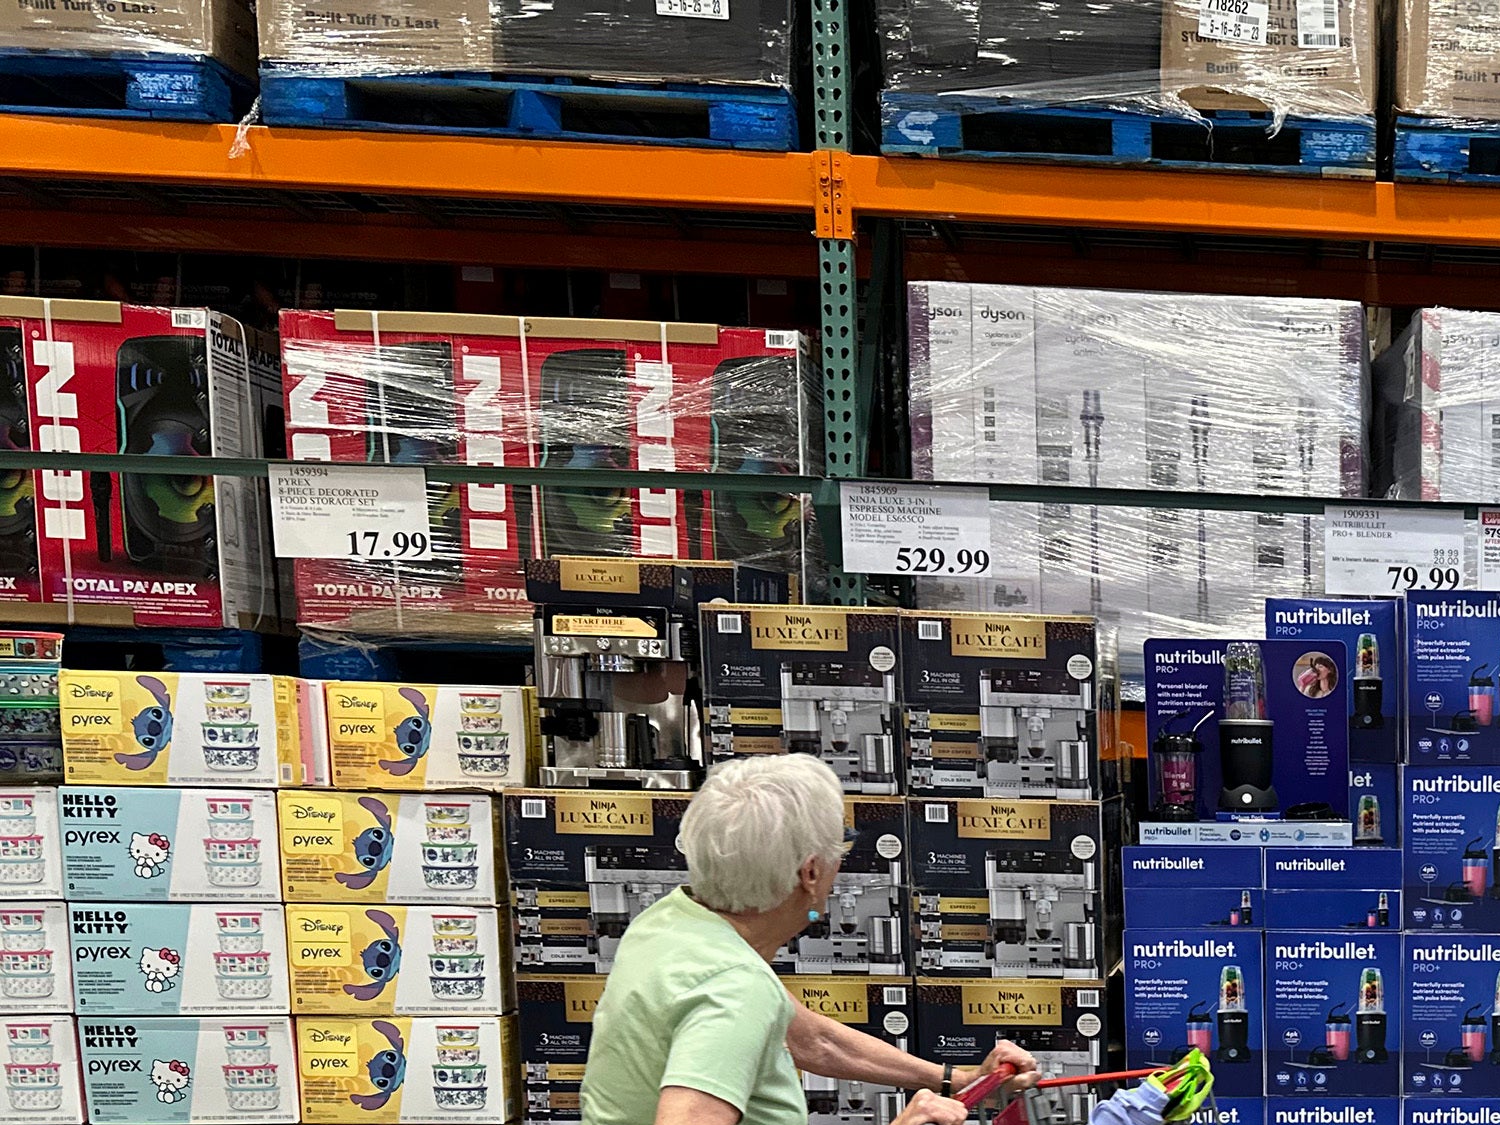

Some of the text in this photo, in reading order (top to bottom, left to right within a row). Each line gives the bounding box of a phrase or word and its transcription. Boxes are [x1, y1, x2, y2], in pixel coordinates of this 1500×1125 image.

[347, 11, 377, 26] Tuff
[381, 15, 400, 28] To
[405, 17, 440, 30] Last
[1454, 70, 1487, 83] Built
[981, 305, 1025, 322] dyson
[288, 466, 328, 477] 1459394
[278, 478, 311, 487] PYREX
[278, 487, 379, 498] 8-PIECE DECORATED
[859, 485, 898, 495] 1845969
[279, 496, 376, 507] FOOD STORAGE SET
[849, 495, 933, 506] NINJA LUXE 3-IN-1
[849, 504, 942, 516] ESPRESSO MACHINE
[1343, 509, 1380, 520] 1909331
[849, 513, 925, 523] MODEL ES655CO
[1332, 521, 1386, 529] NUTRIBULLET
[1356, 531, 1392, 539] BLENDER
[347, 530, 427, 557] 17.99
[896, 547, 990, 575] 529.99
[1387, 566, 1460, 591] 79.99
[151, 581, 197, 596] APEX
[314, 583, 443, 599] TOTAL APEX
[573, 618, 626, 627] START HERE
[1416, 620, 1445, 630] PRO+
[755, 625, 844, 642] LUXE CAFÉ
[1276, 626, 1303, 636] PRO+
[71, 714, 113, 727] pyrex
[62, 794, 116, 807] HELLO
[63, 806, 119, 819] KITTY
[559, 809, 650, 825] LUXE CAFÉ
[64, 829, 120, 847] pyrex
[292, 832, 333, 847] pyrex
[1133, 960, 1162, 970] PRO+
[967, 1000, 1056, 1016] LUXE CAFÉ
